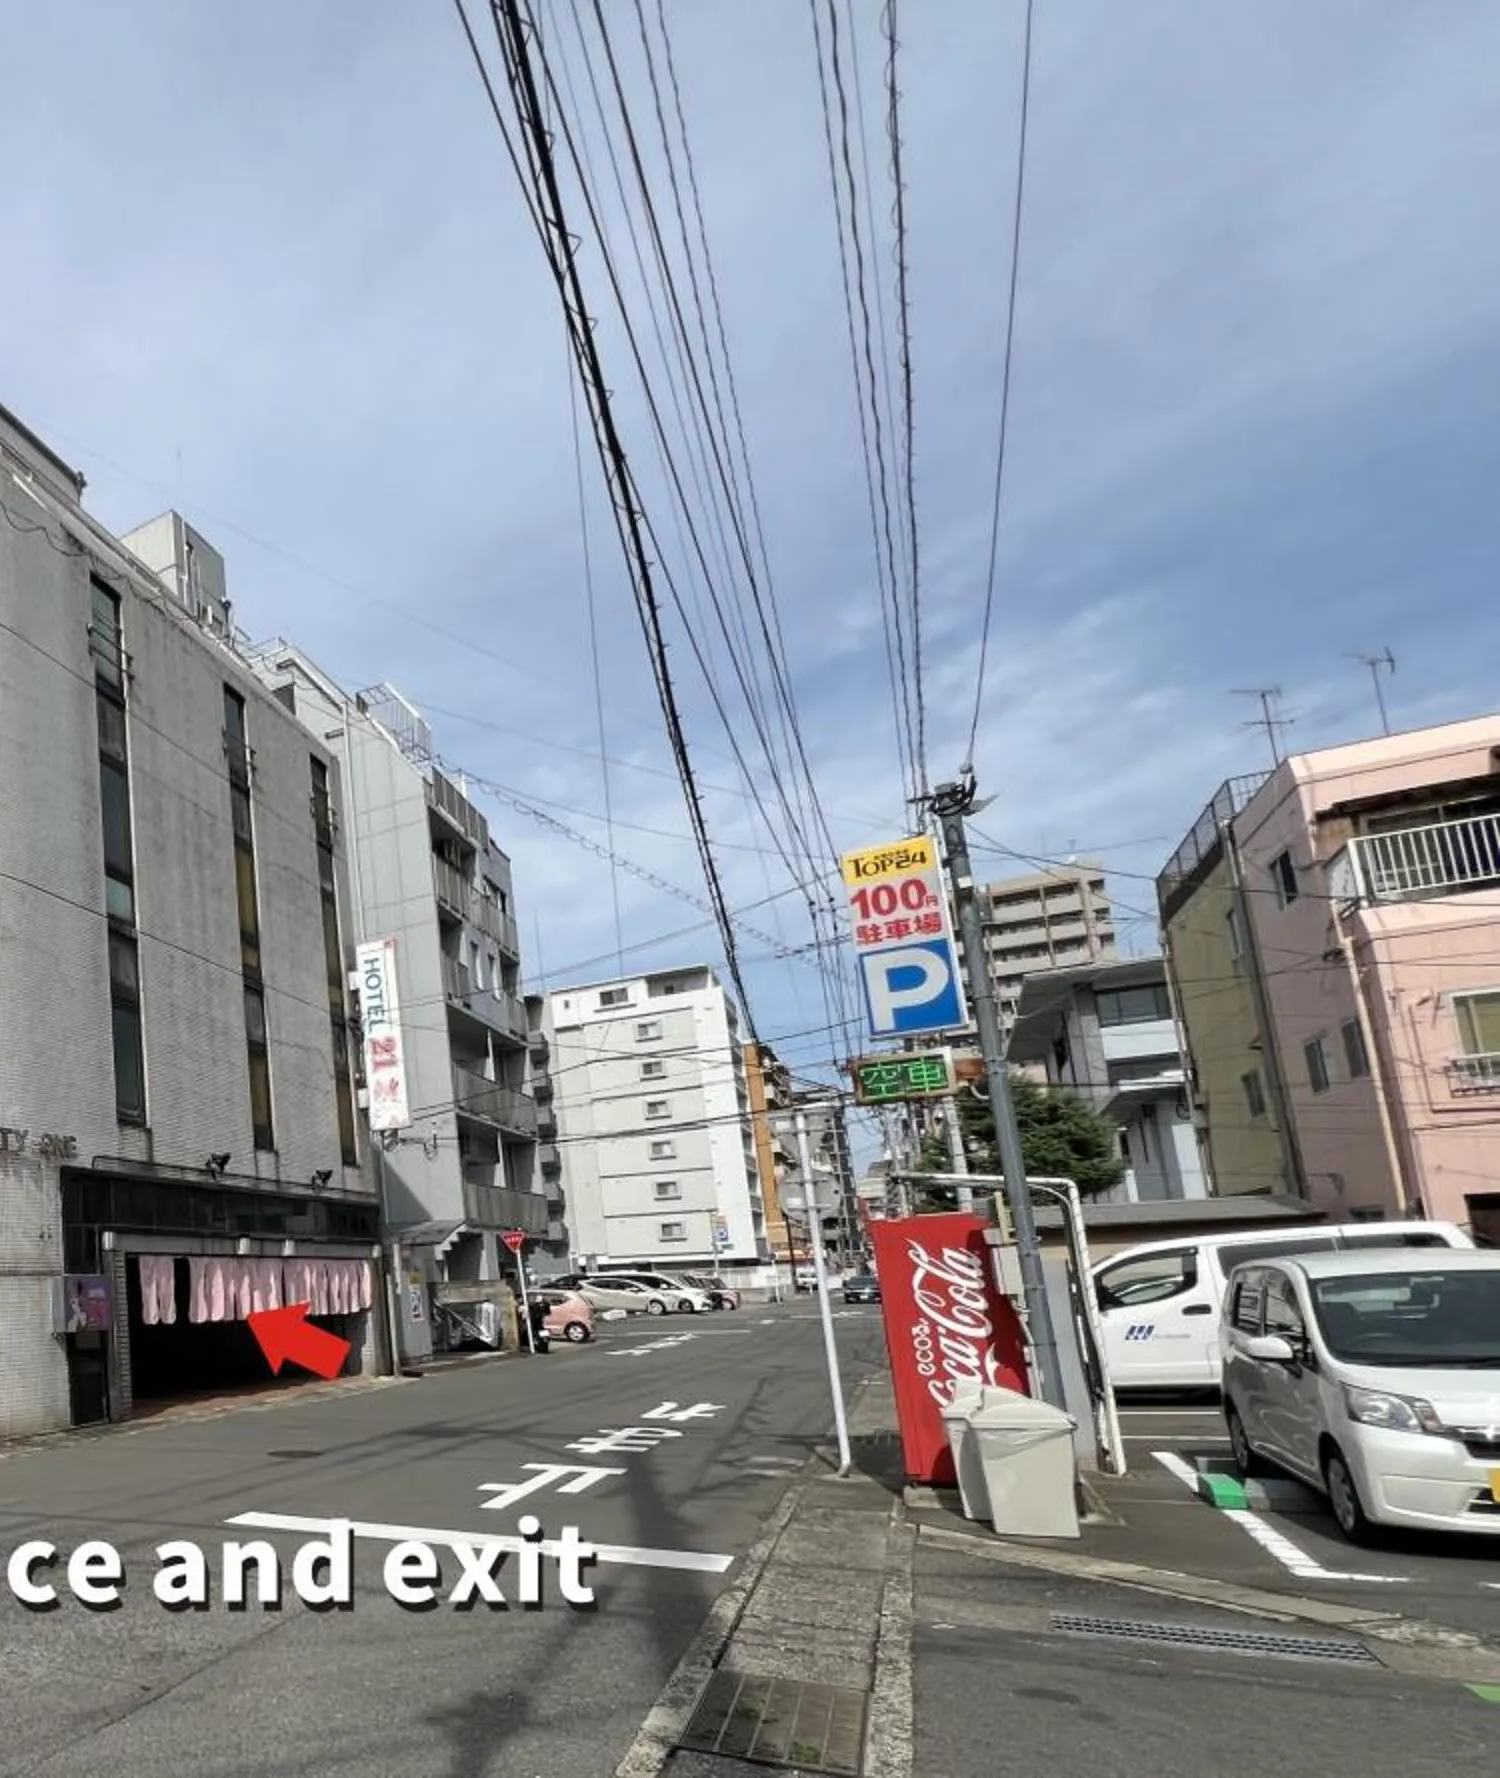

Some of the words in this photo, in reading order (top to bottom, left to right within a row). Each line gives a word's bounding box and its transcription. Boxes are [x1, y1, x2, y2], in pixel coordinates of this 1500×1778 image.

[856, 911, 942, 946] 駐車場
[364, 957, 386, 1033] HOTEL
[368, 1036, 399, 1074] 21
[859, 1057, 947, 1099] 空車
